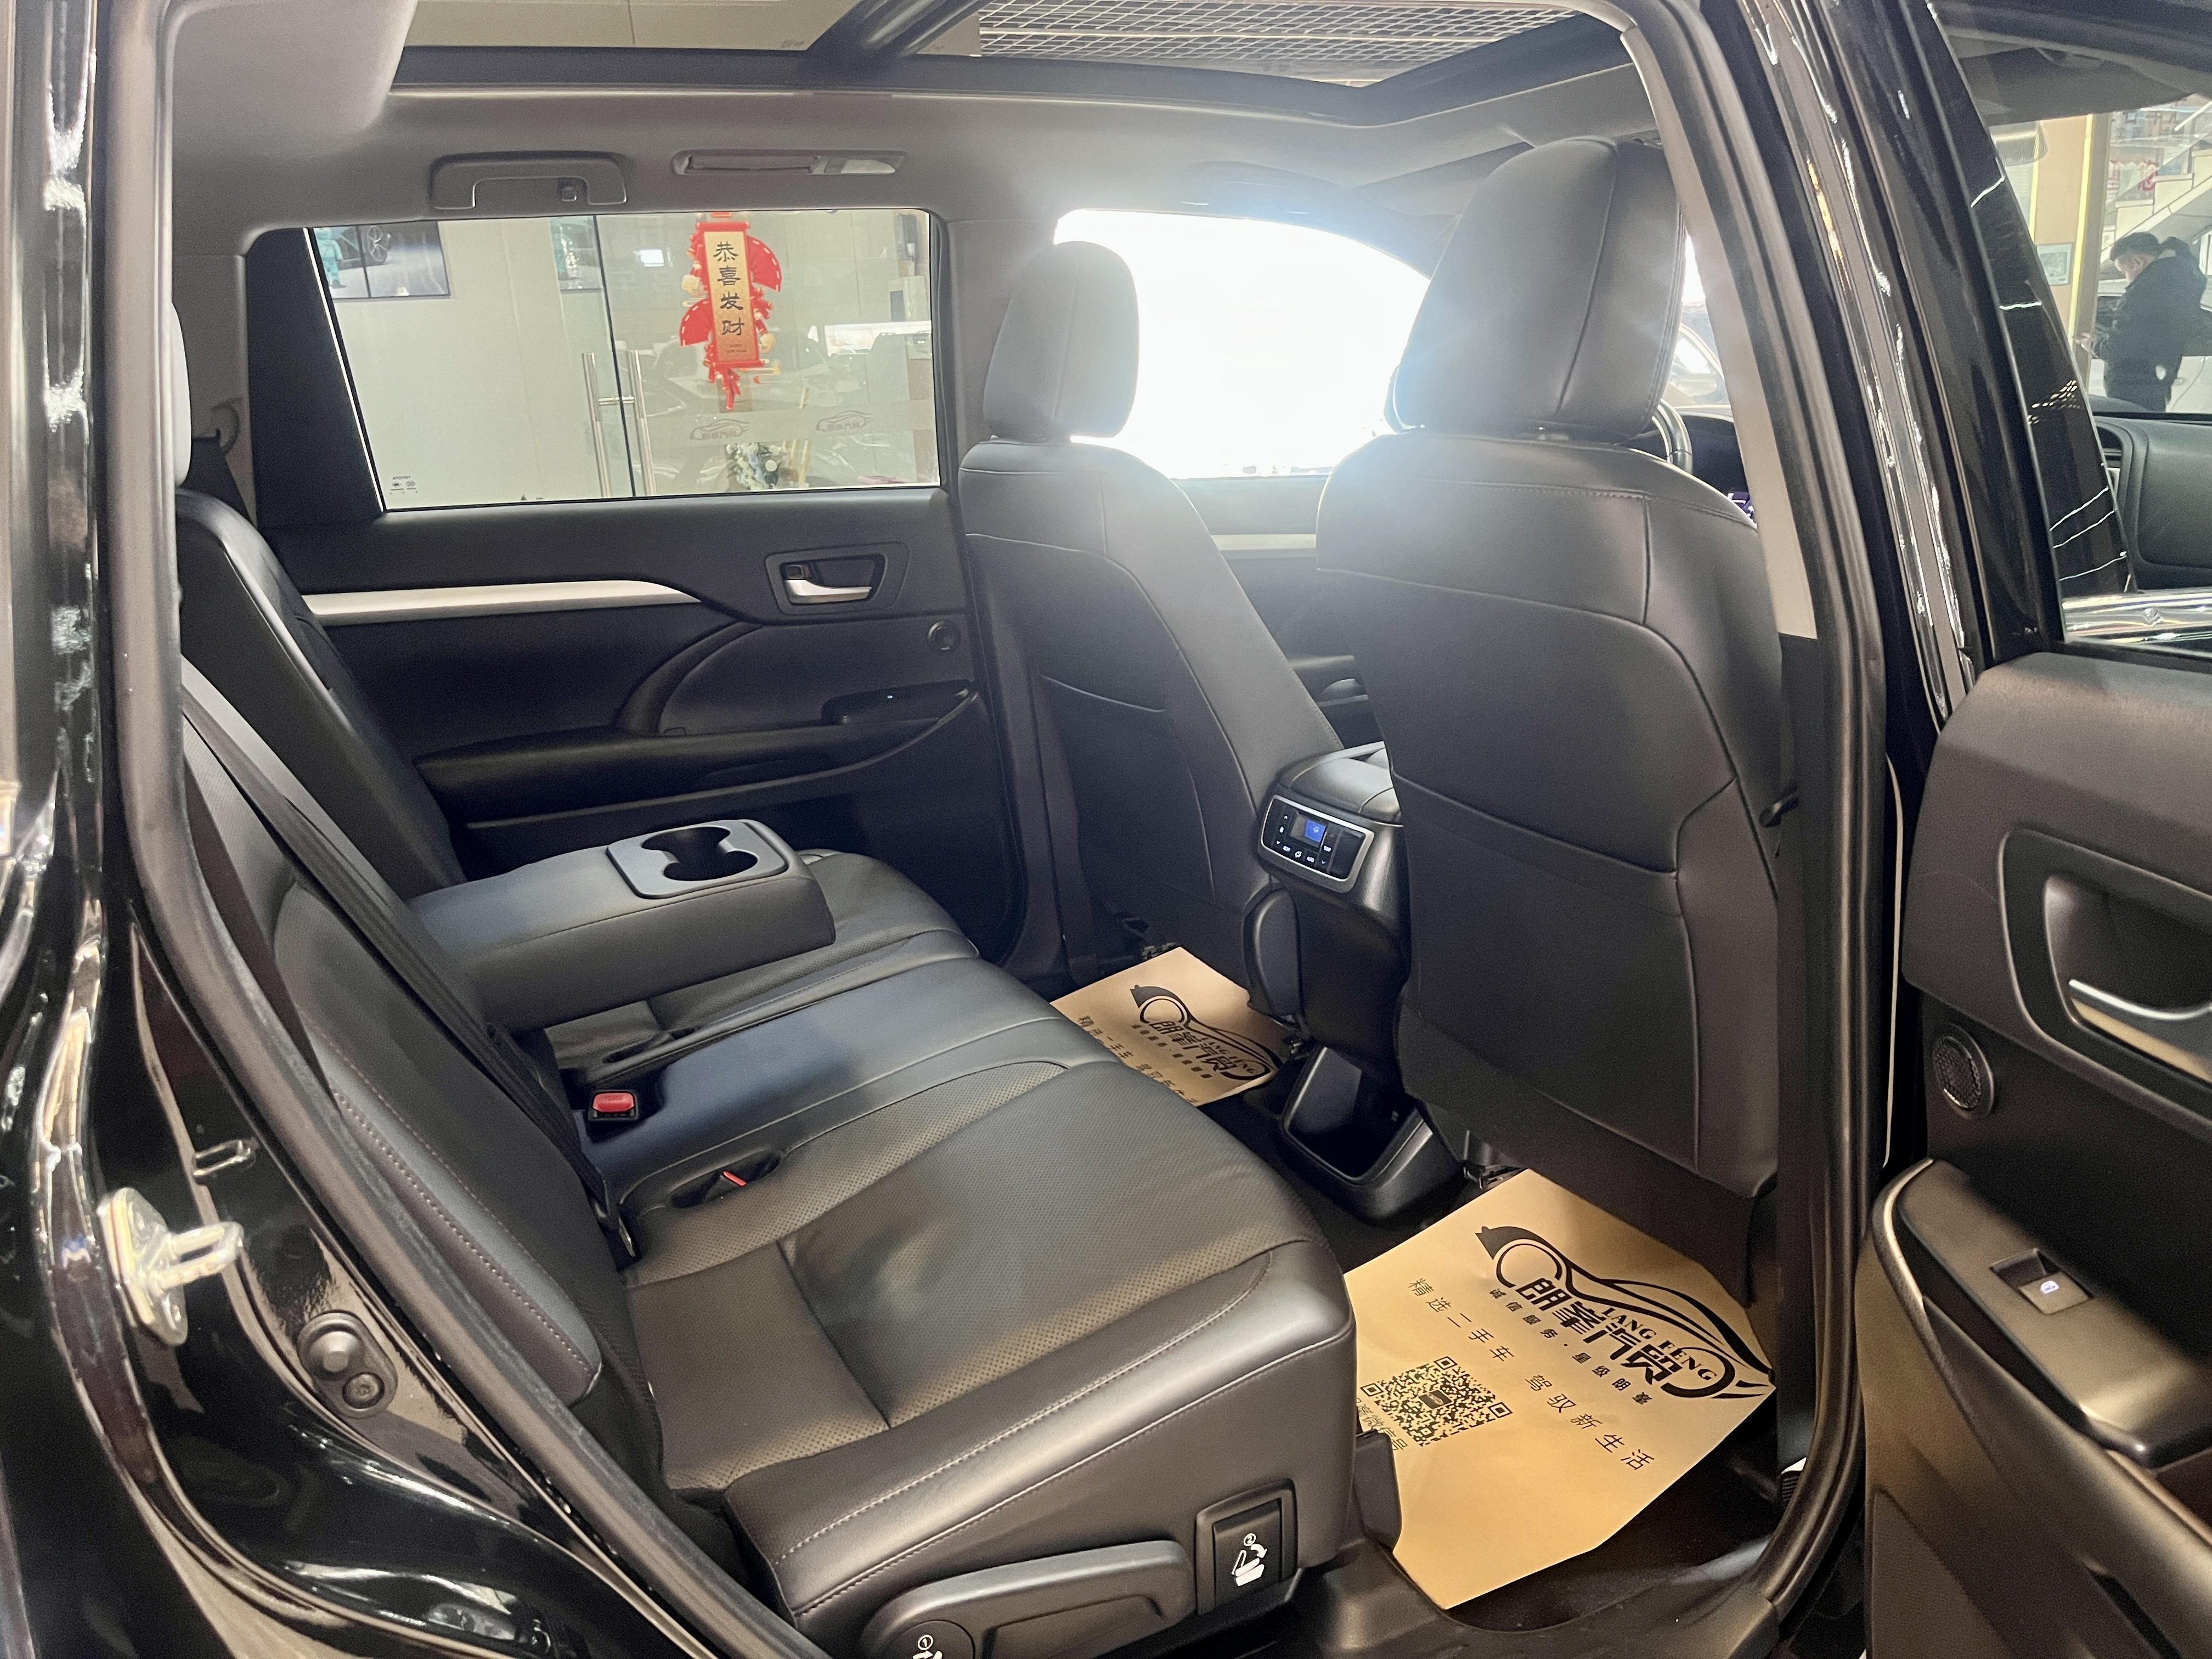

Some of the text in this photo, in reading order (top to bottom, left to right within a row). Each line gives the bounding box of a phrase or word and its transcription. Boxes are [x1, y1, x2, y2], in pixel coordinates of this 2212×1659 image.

[713, 241, 744, 336] 恭喜发财
[1408, 1278, 1655, 1470] 精选二手车 驾驭新生活
[1601, 1307, 1718, 1380] LANG FENG
